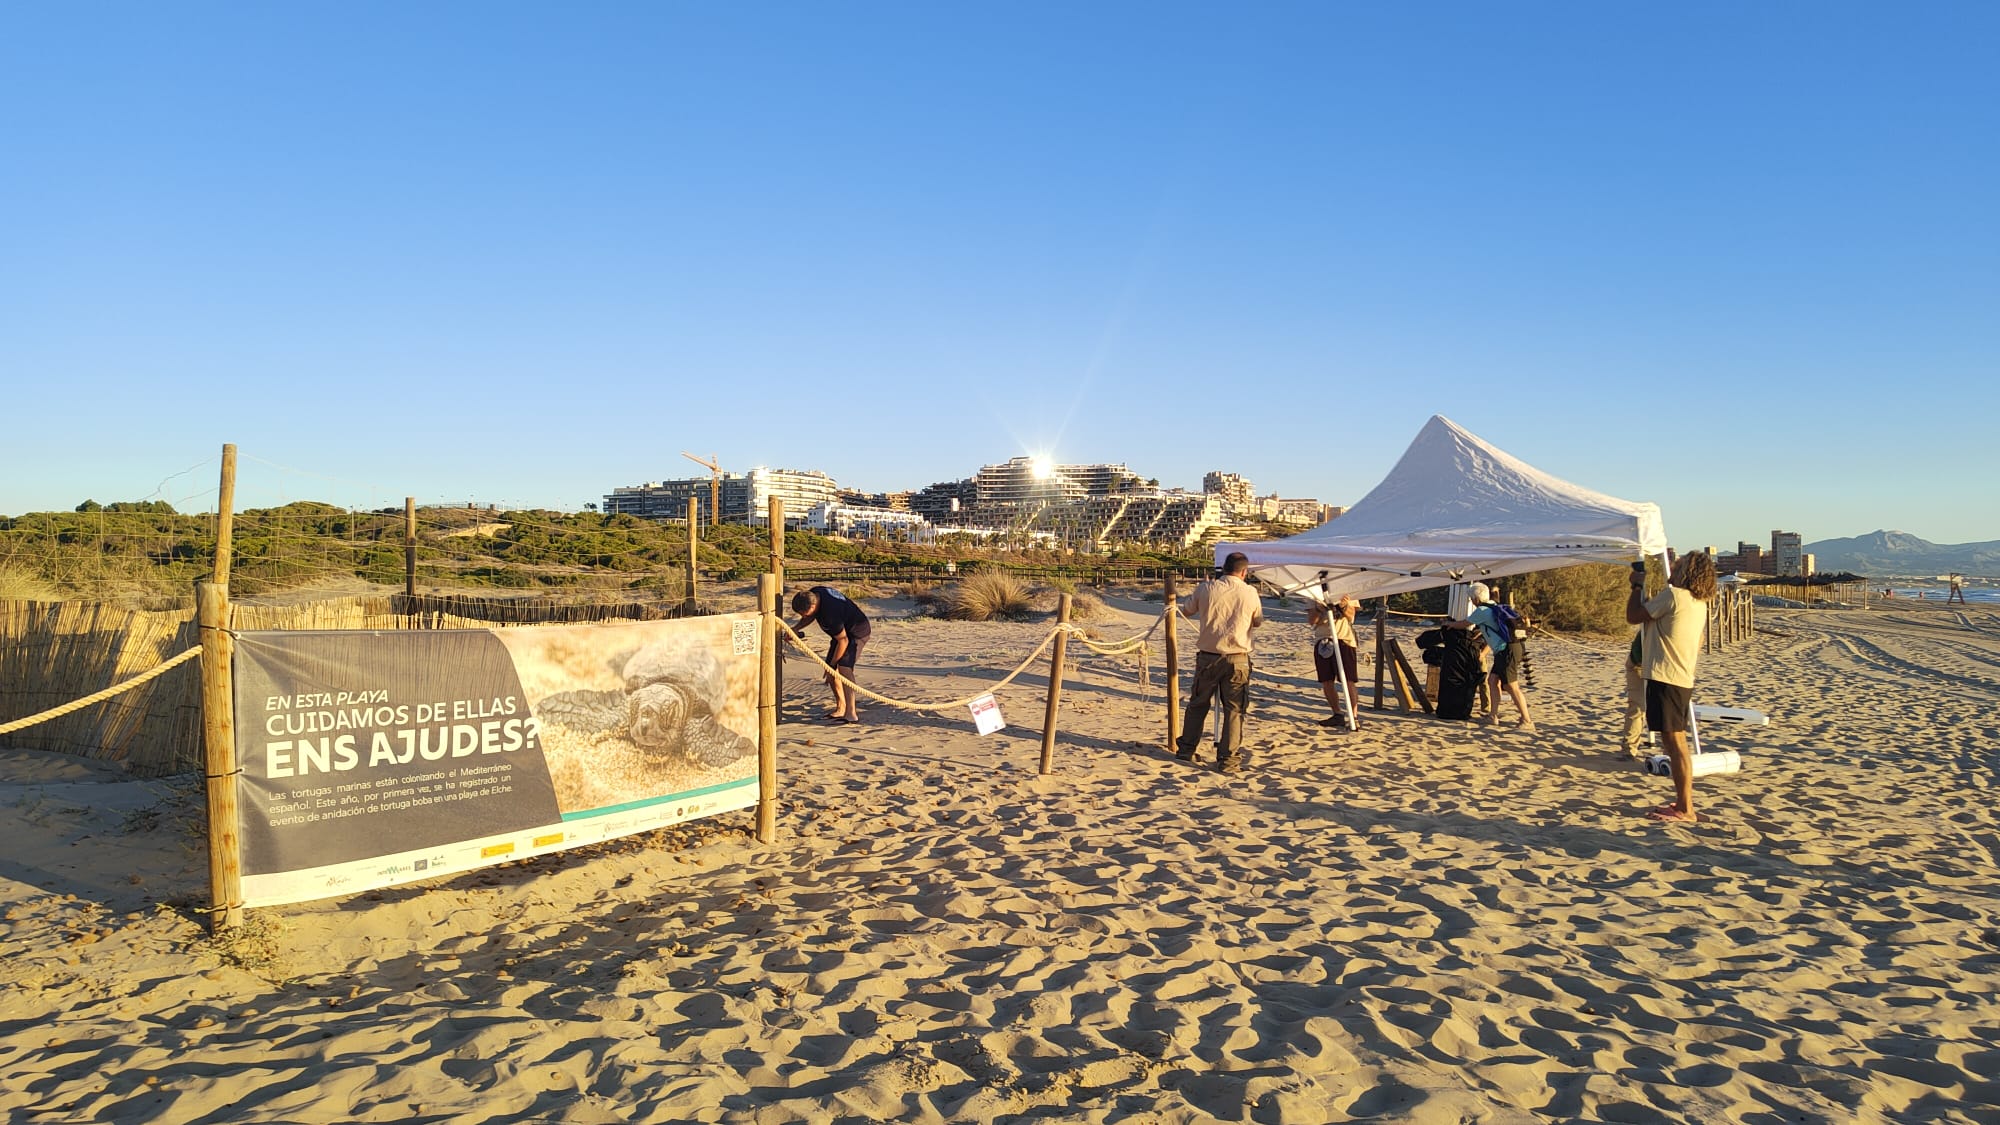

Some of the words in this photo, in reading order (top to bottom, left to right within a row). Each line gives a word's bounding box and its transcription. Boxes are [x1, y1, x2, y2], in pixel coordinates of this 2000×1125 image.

[266, 696, 291, 710] EN
[296, 693, 332, 708] ESTA
[336, 690, 388, 705] PLAYA
[266, 706, 409, 736] CUIDAMOS
[417, 703, 446, 723] DE
[454, 696, 516, 719] ELLAS
[267, 735, 359, 778] ENS
[369, 717, 541, 767] AJUDES?
[269, 791, 286, 801] Las
[292, 786, 332, 798] tortugas
[337, 781, 372, 792] marinas
[376, 777, 398, 788] están
[402, 771, 445, 784] colonizando
[449, 769, 456, 778] el
[461, 764, 512, 776] Mediterráneo
[269, 801, 311, 814] español.
[317, 799, 336, 808] Este
[341, 796, 360, 805] año,
[364, 794, 379, 803] por
[383, 788, 414, 800] primera
[459, 776, 497, 788] registrado
[270, 815, 304, 826] evento
[307, 812, 320, 822] de
[322, 806, 365, 820] anidación
[367, 804, 379, 813] de
[380, 800, 410, 811] tortuga
[413, 796, 432, 806] boba
[459, 789, 478, 800] playa
[480, 788, 490, 796] de
